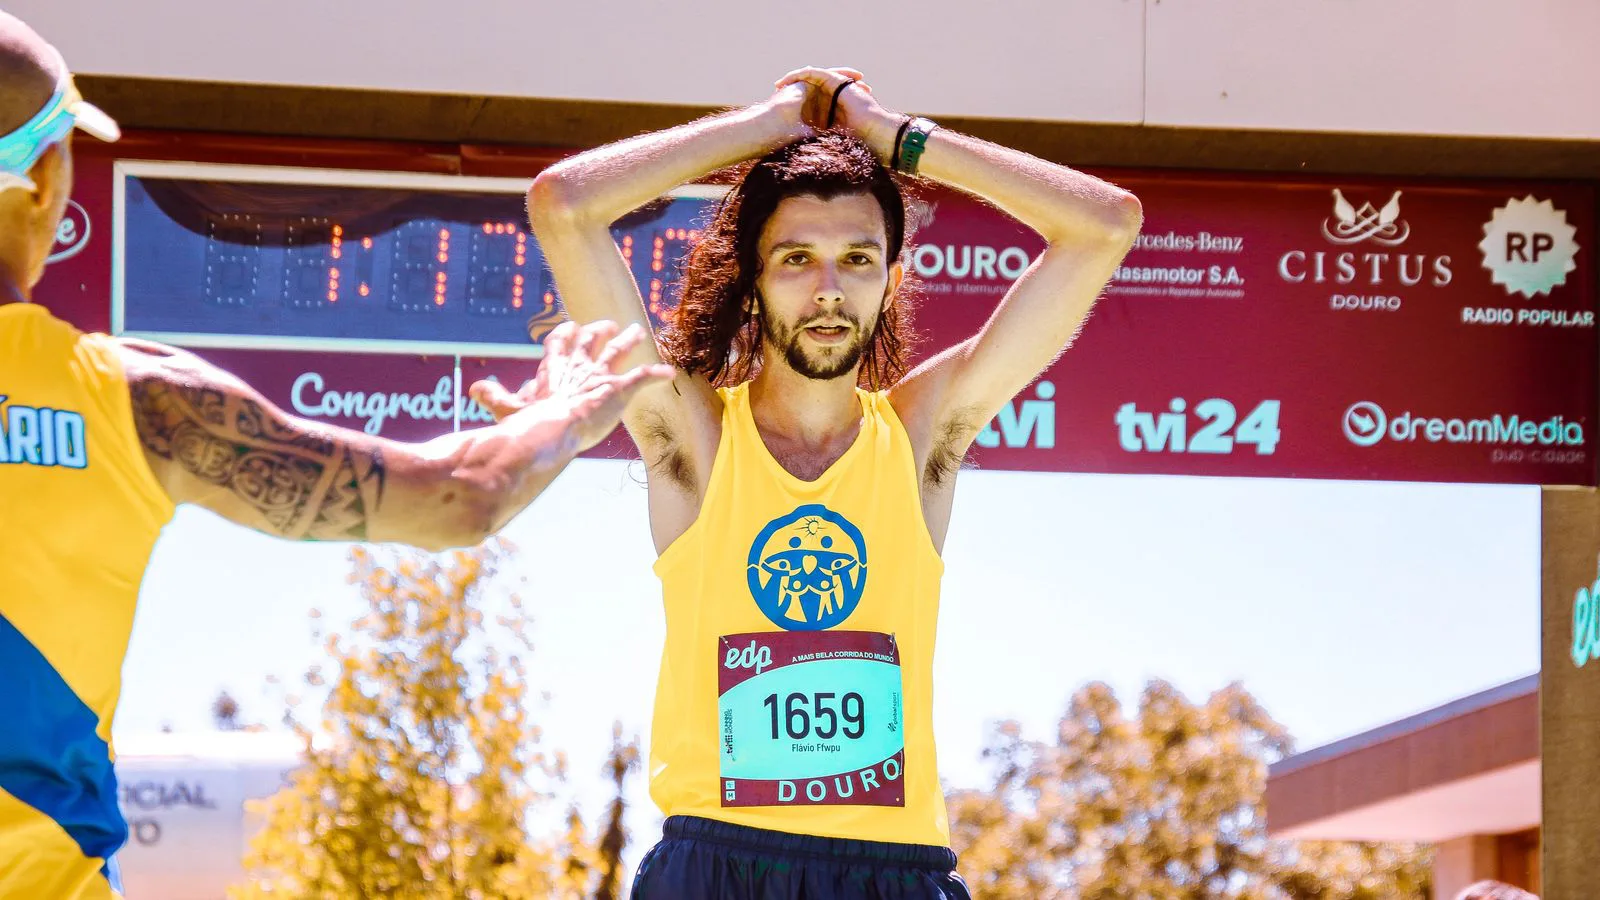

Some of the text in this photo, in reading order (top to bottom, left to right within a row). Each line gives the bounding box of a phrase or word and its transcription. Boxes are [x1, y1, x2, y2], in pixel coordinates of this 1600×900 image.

[1135, 231, 1243, 252] rcedes-Benz
[1507, 232, 1554, 263] RP
[903, 243, 1029, 279] OURO
[1209, 265, 1245, 285] S.A.
[1279, 250, 1452, 286] CISTUS
[1331, 295, 1401, 312] DOURO
[1462, 307, 1594, 326] RADIO POPULAR
[1115, 397, 1281, 455] tvi24
[1389, 411, 1584, 445] dreamMedia
[724, 640, 773, 675] edp
[798, 653, 815, 662] MAIS
[815, 651, 834, 659] BELA
[864, 651, 874, 659] DO
[874, 653, 894, 662] MUNDO
[764, 692, 865, 740] 1659
[792, 743, 841, 753] Flávio Ffwpu
[778, 759, 900, 802] DOURO
